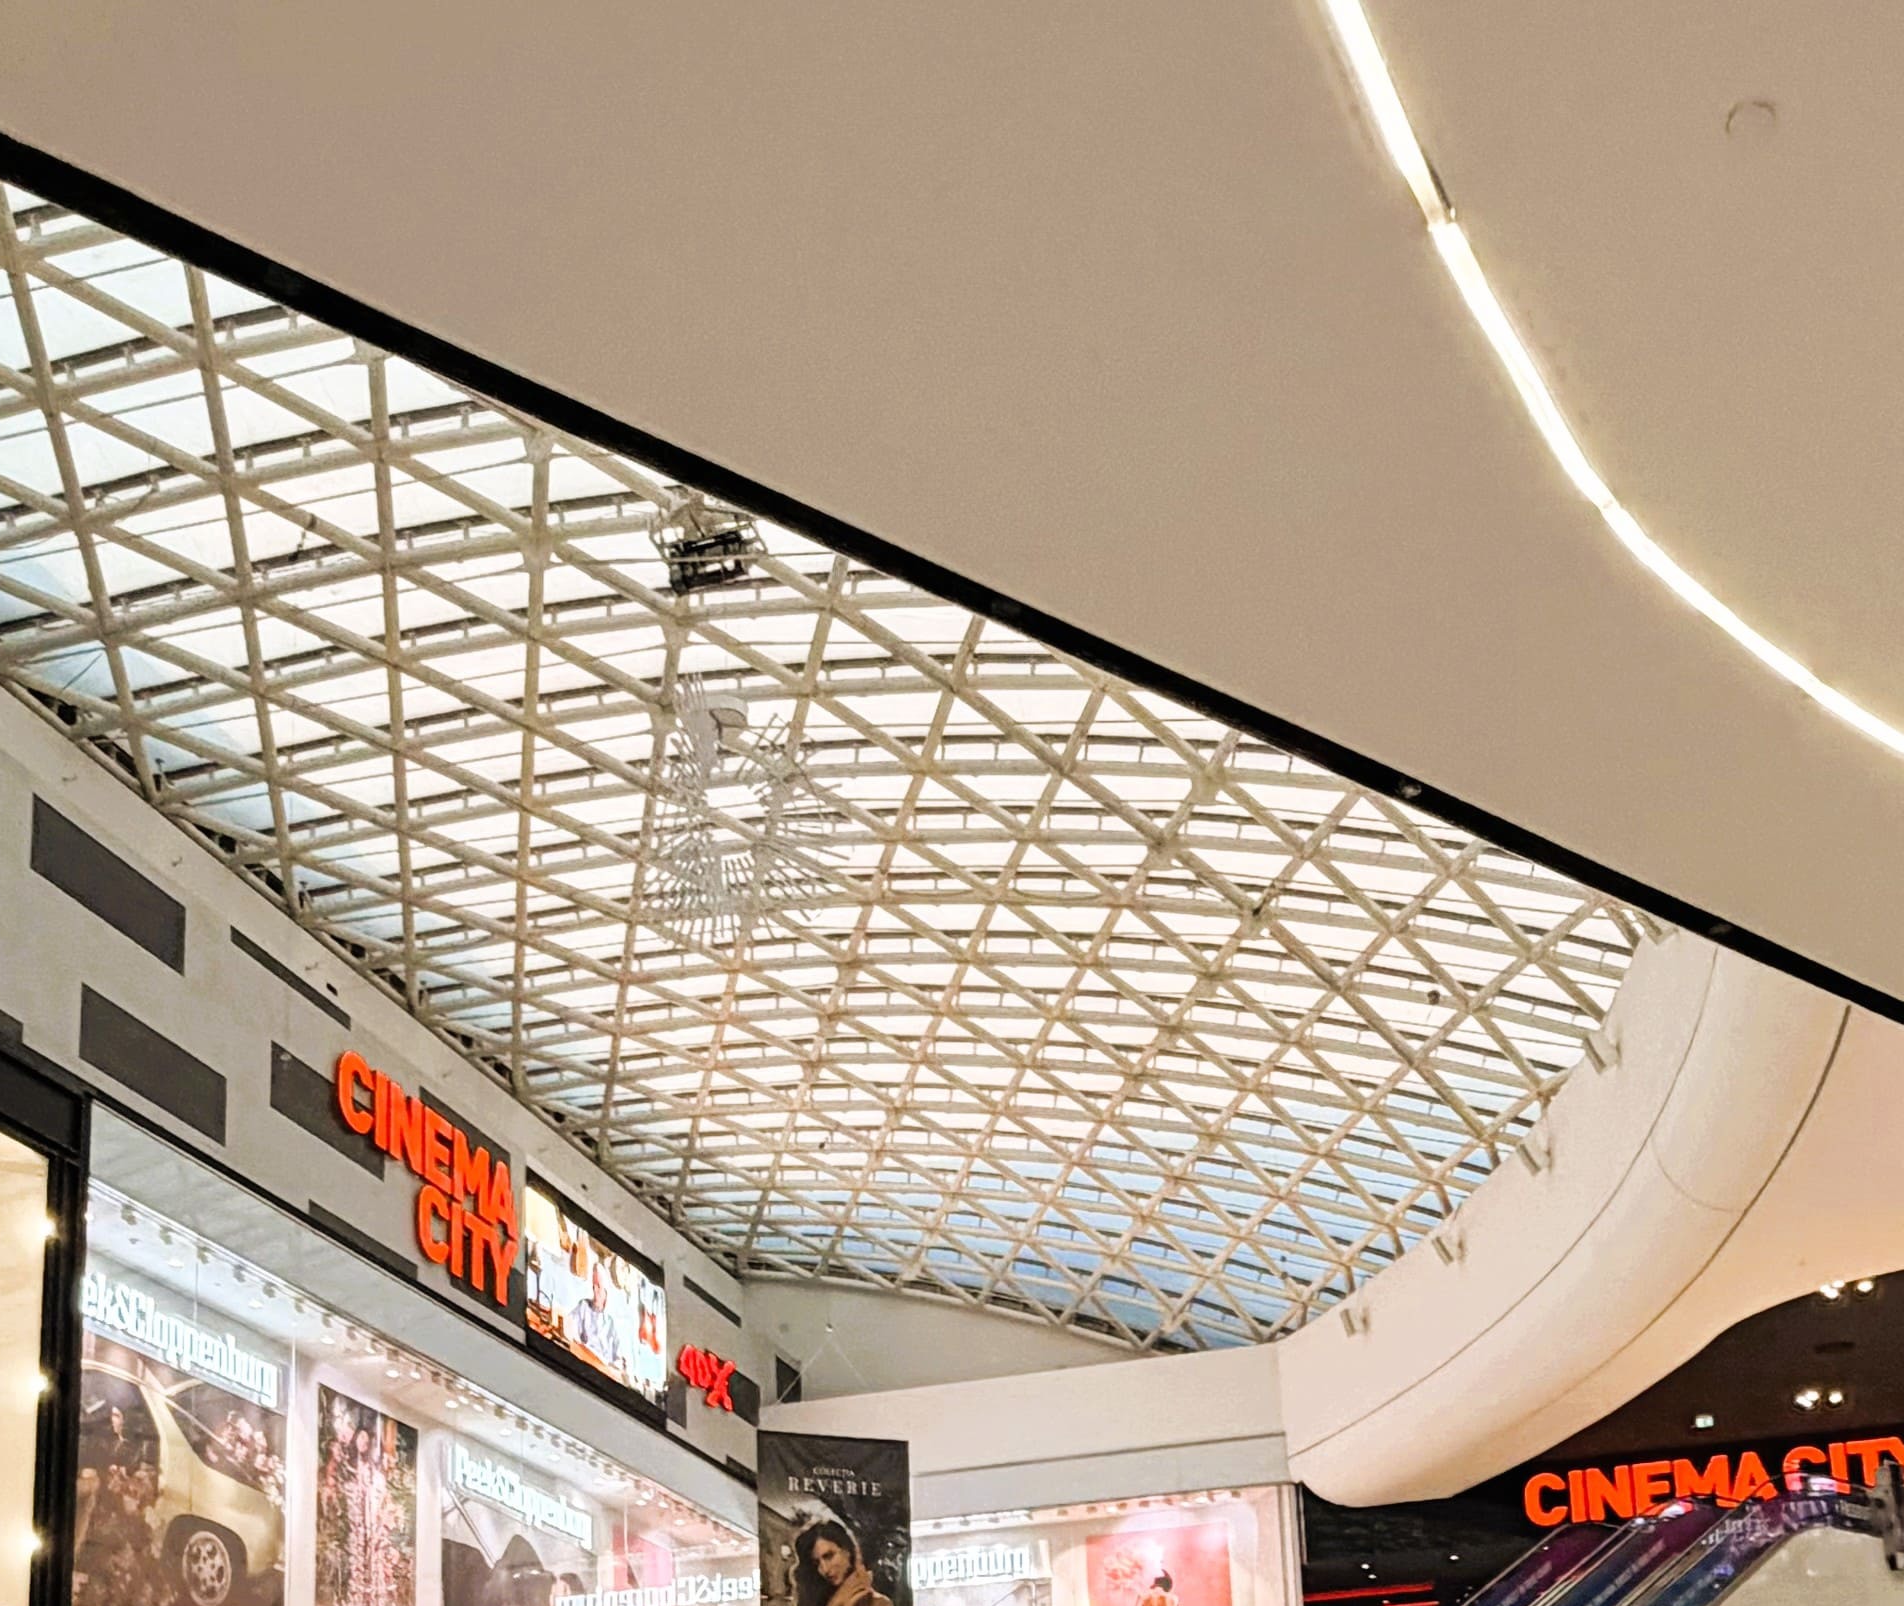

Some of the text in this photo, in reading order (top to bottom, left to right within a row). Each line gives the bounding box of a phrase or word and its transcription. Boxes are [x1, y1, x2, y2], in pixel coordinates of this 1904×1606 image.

[338, 1051, 517, 1242] CINEMA
[418, 1184, 517, 1307] CITY
[788, 1476, 882, 1497] REVERIE
[1524, 1451, 1777, 1527] CINEMA
